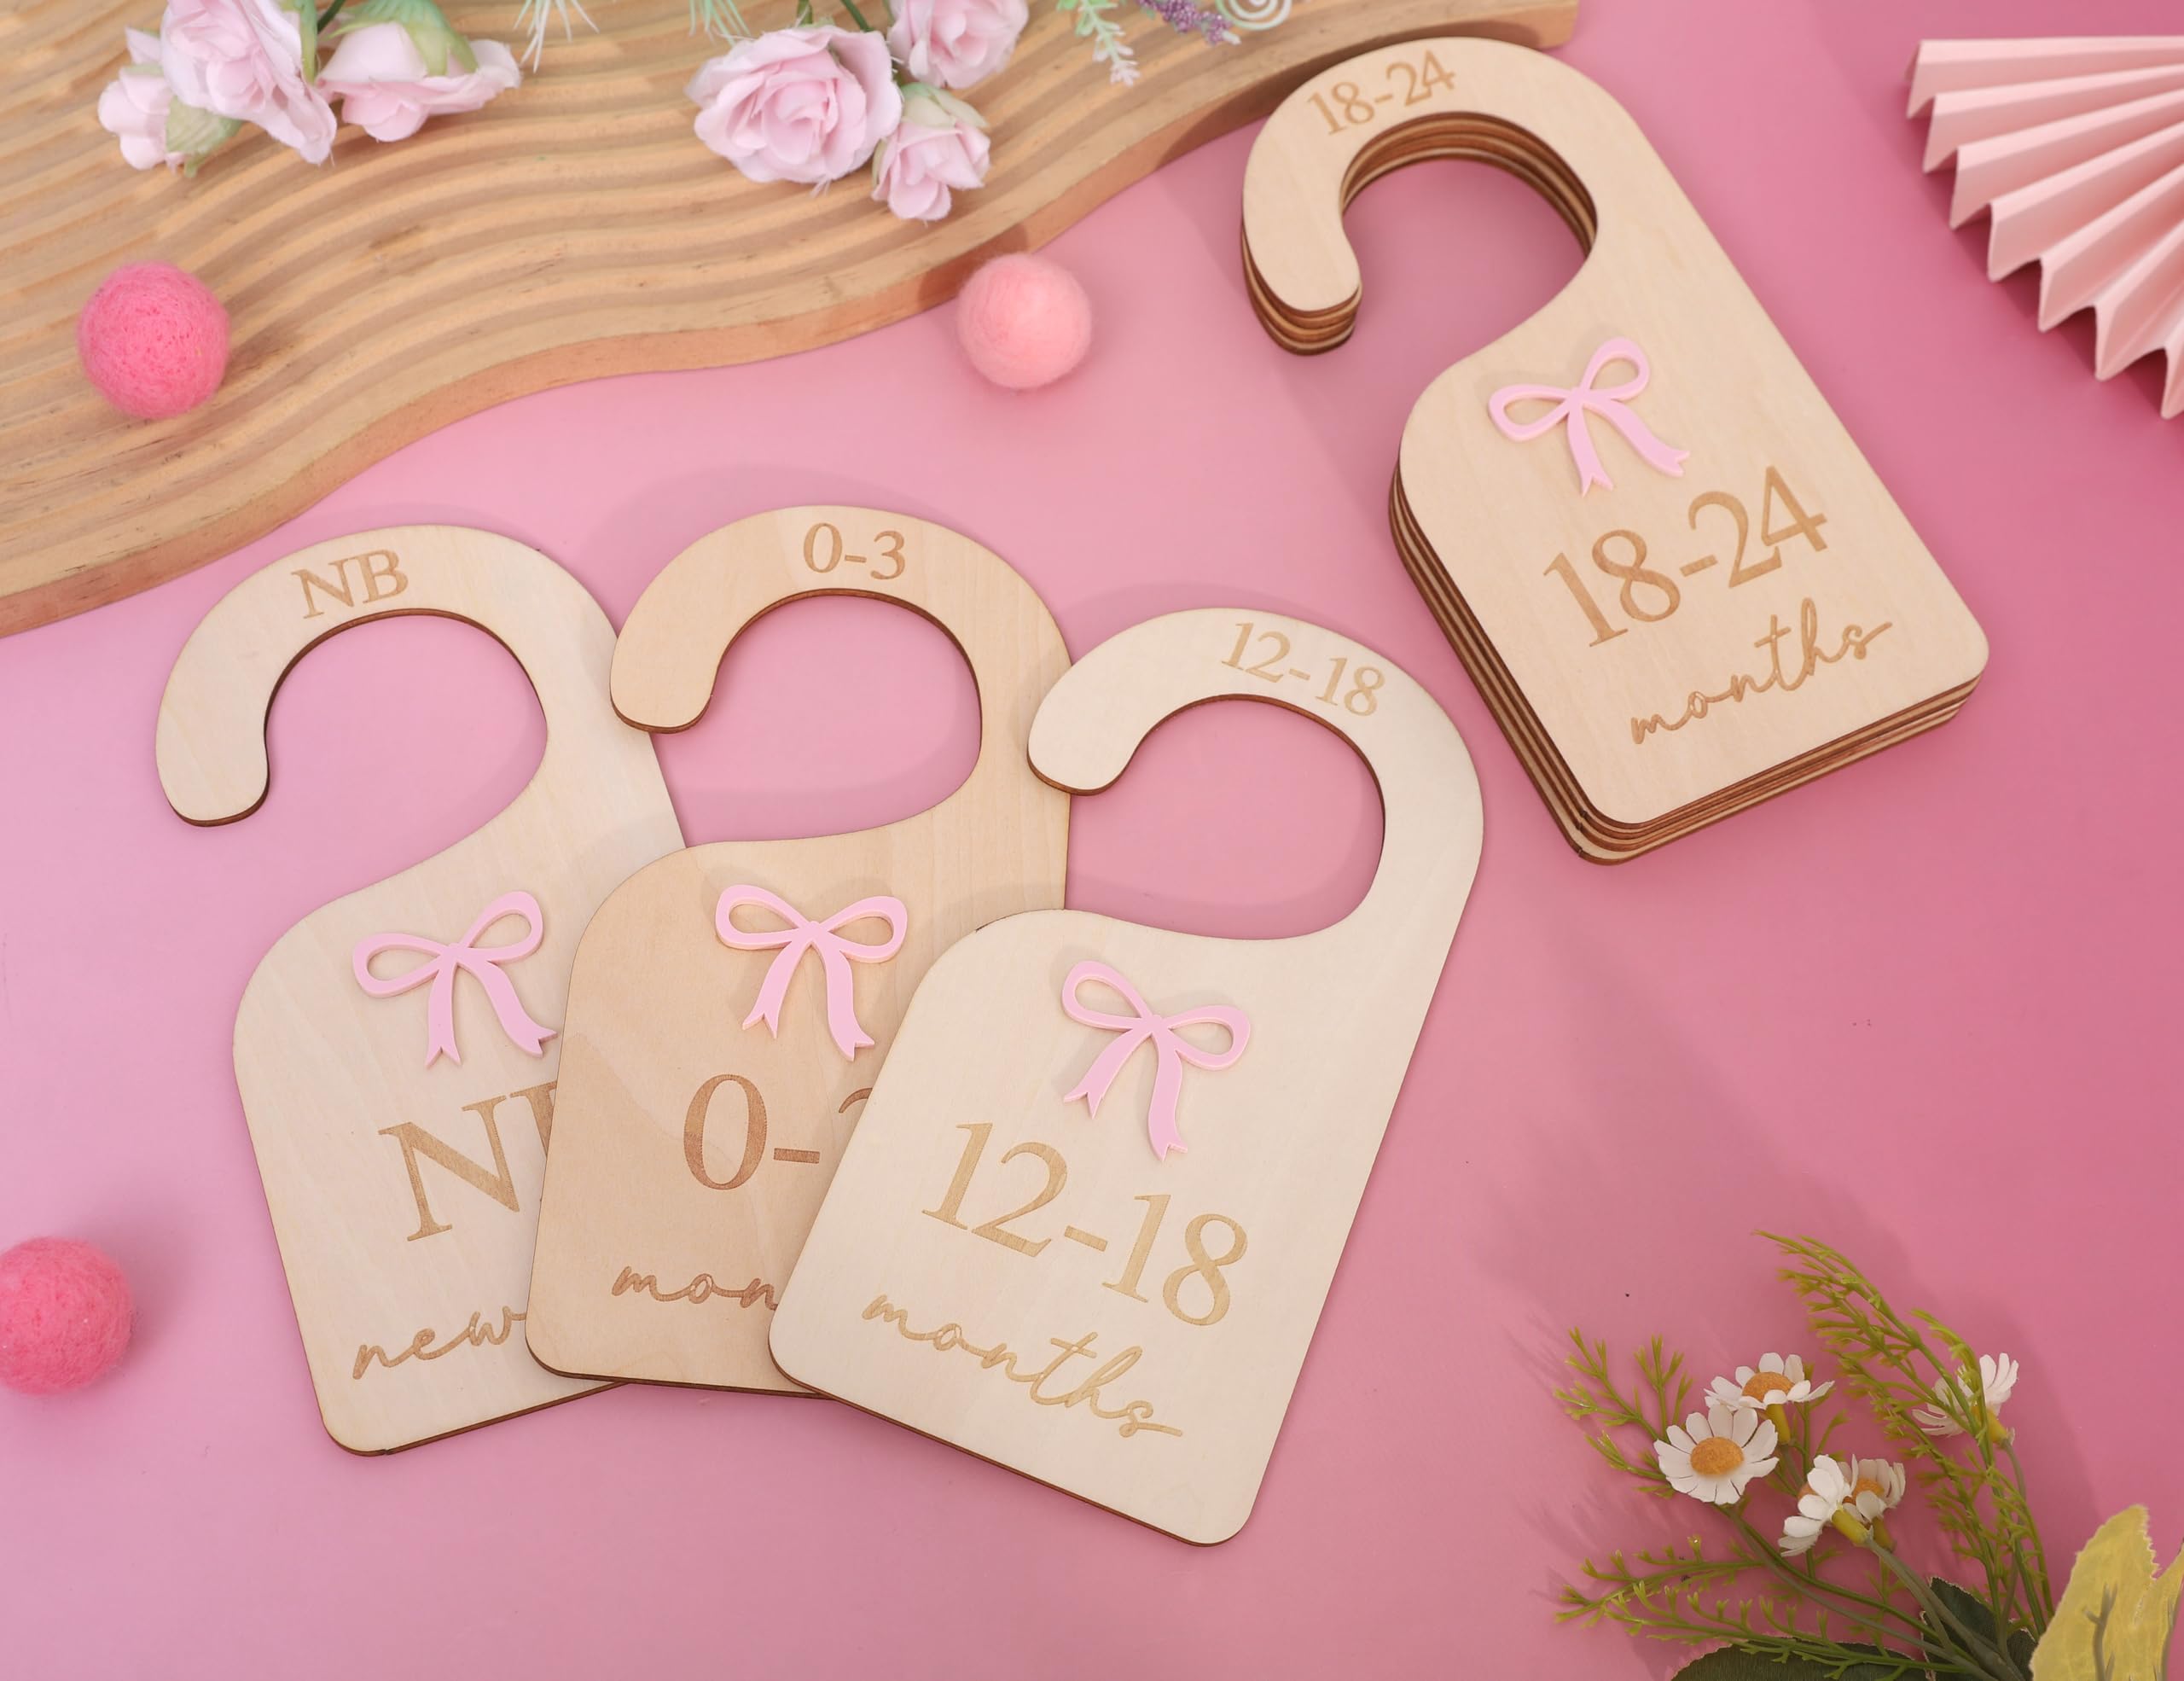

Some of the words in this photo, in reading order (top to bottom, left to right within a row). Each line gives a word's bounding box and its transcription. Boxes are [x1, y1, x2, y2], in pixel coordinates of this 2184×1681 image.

[1307, 49, 1455, 136] 18-24
[291, 549, 410, 619] NB
[803, 522, 907, 579] 0-3
[1543, 465, 1828, 647] 18-24
[1221, 621, 1385, 716] 12-18
[1630, 598, 1893, 744] months
[378, 1080, 558, 1242] N
[682, 1073, 874, 1190] 0-
[921, 1122, 1249, 1326] 12-18
[612, 1265, 778, 1312] mon
[352, 1306, 526, 1380] new
[862, 1294, 1183, 1438] months
